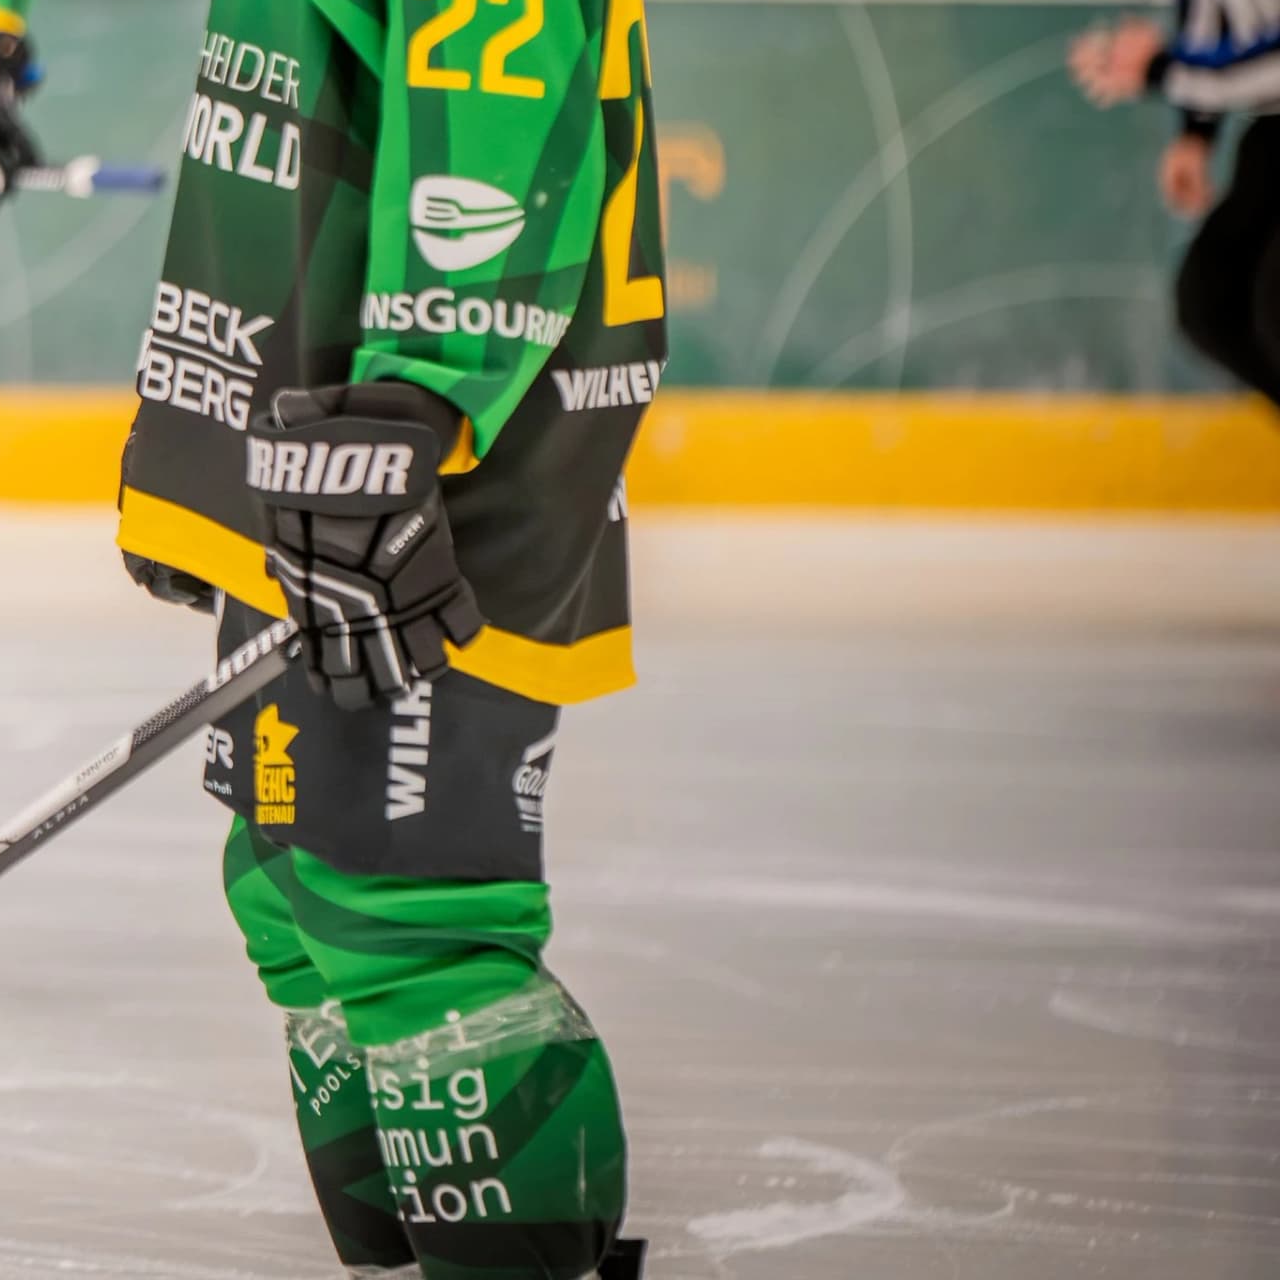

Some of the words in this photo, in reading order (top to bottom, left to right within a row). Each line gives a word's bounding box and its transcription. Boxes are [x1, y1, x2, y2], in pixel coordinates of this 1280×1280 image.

[137, 330, 255, 431] BERG
[387, 513, 425, 555] COVERT
[33, 795, 88, 839] ALPHA
[309, 1053, 361, 1116] POOLS
